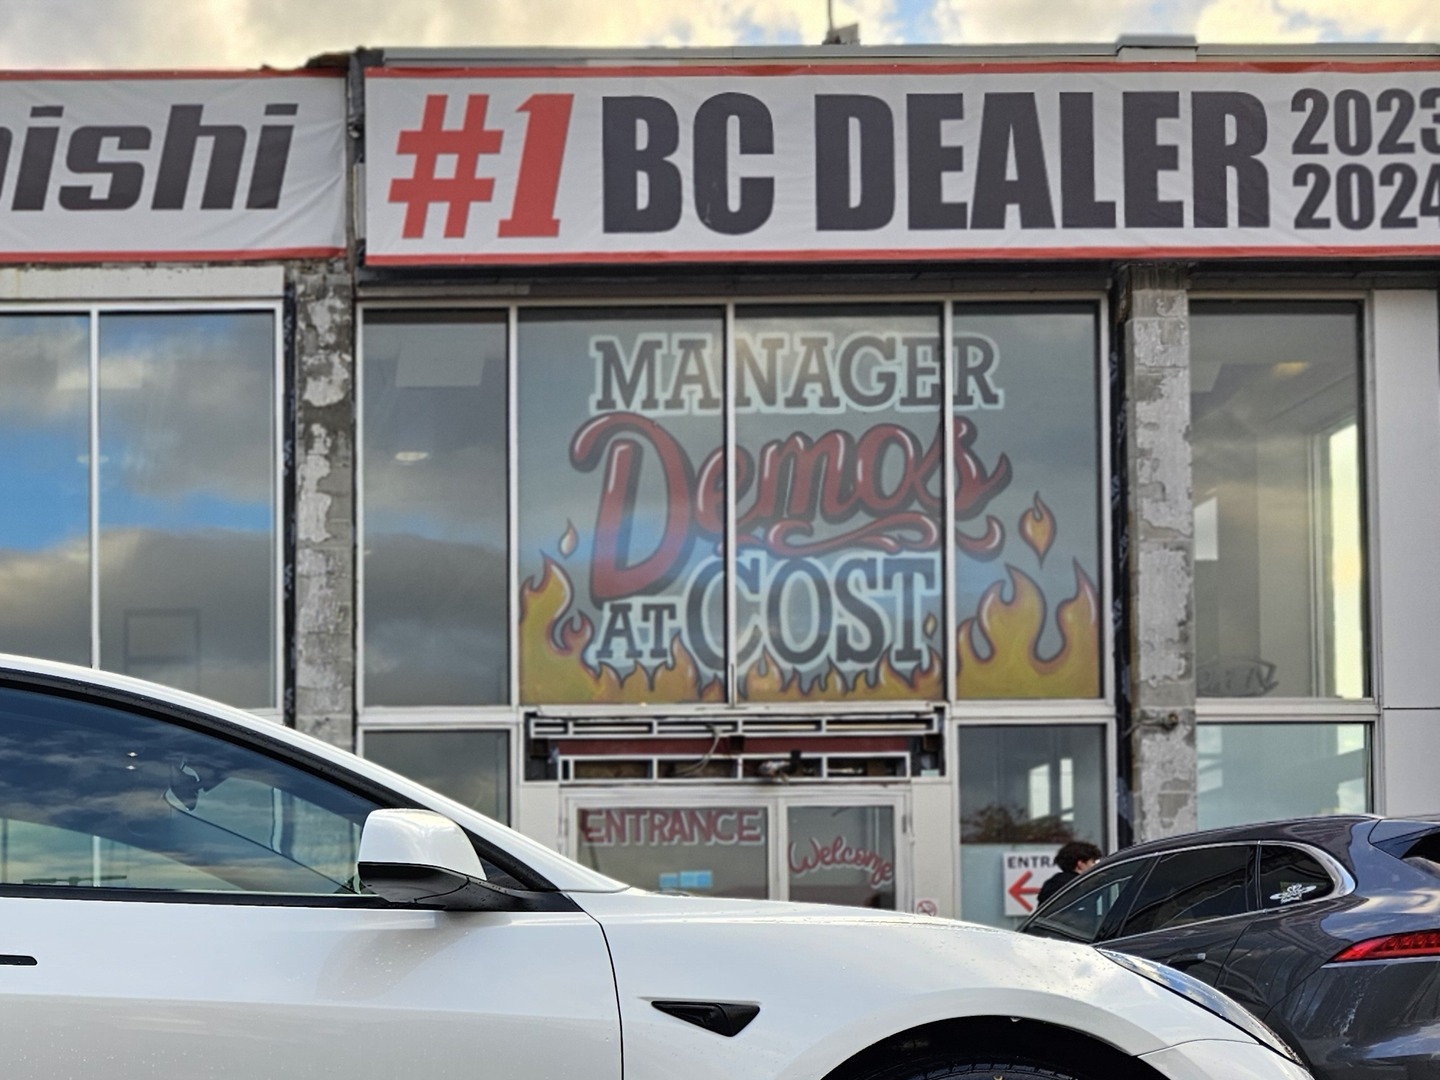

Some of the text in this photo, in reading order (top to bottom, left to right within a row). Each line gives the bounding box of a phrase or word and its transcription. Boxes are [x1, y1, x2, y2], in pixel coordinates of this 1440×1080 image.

[387, 90, 1272, 239] #1 BC DEALER
[590, 333, 1004, 414] MANAGER
[569, 411, 1013, 607] Demos
[597, 553, 940, 674] AT COST
[581, 809, 766, 846] ENTRANCE
[788, 836, 894, 888] Welcome
